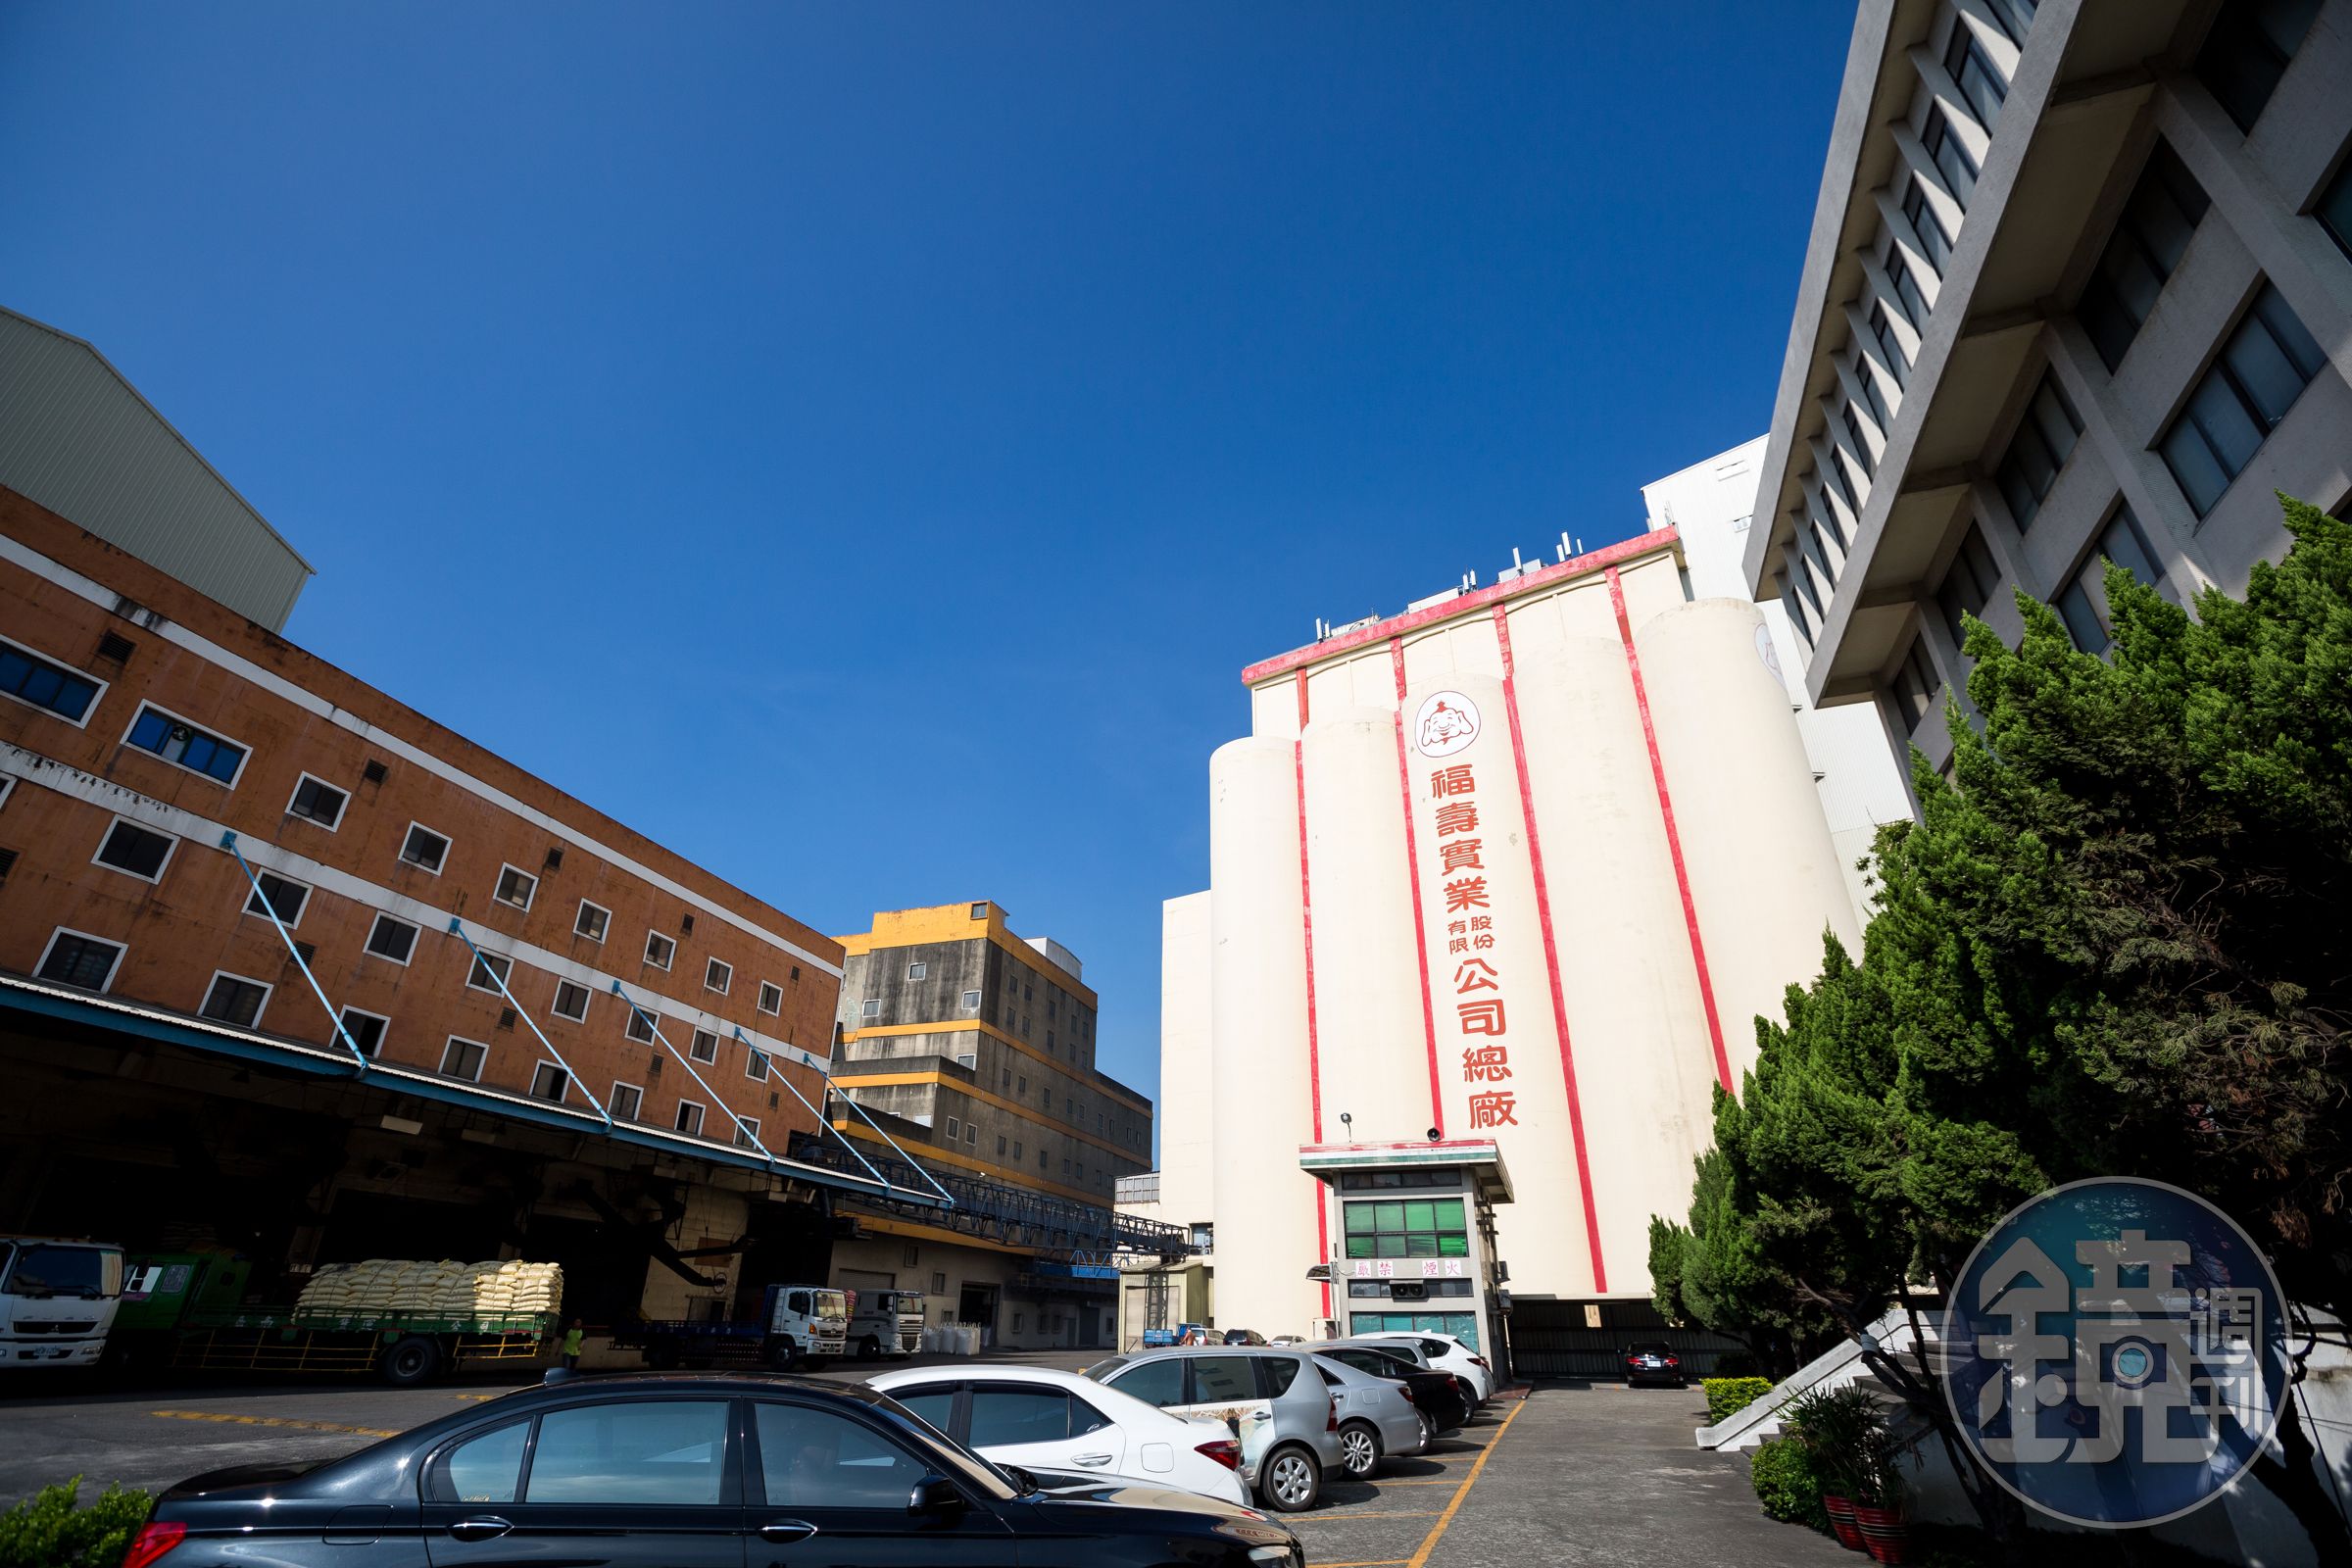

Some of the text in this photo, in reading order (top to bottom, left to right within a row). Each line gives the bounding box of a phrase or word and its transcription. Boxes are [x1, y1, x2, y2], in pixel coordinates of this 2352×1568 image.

[1431, 763, 1491, 914] 福壽實業
[1454, 957, 1519, 1130] 公司總廠
